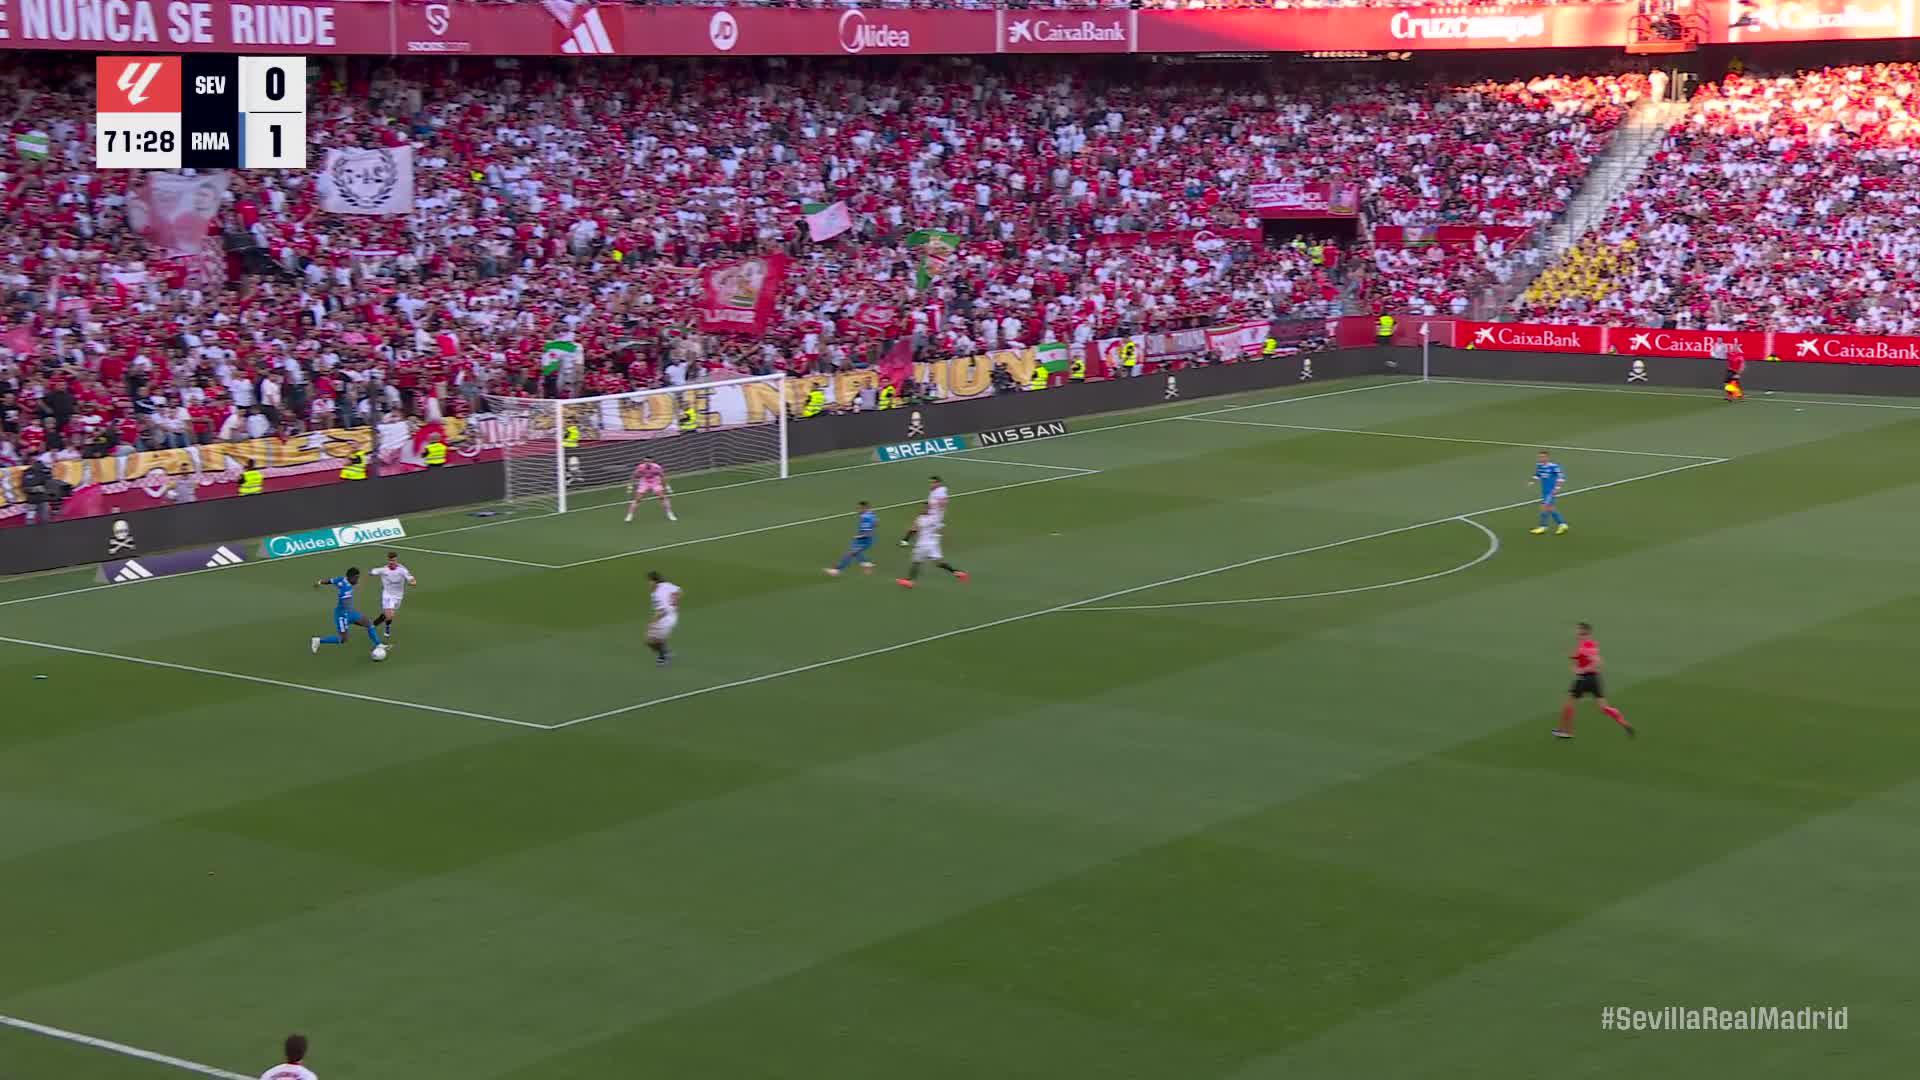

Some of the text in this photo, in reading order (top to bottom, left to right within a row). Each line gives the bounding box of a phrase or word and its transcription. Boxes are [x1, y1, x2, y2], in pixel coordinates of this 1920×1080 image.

[20, 0, 160, 42] NUNCA
[167, 1, 215, 44] SE
[230, 4, 337, 46] RINDE
[1033, 20, 1126, 41] CaixaBank
[1498, 328, 1581, 348] CaixaBank
[1655, 333, 1744, 354] CaixaBnk
[1823, 339, 1920, 360] CaixaBank
[981, 422, 1066, 446] NISSAN
[899, 437, 958, 458] REALE
[339, 525, 402, 544] Midea
[270, 536, 336, 556] Midea
